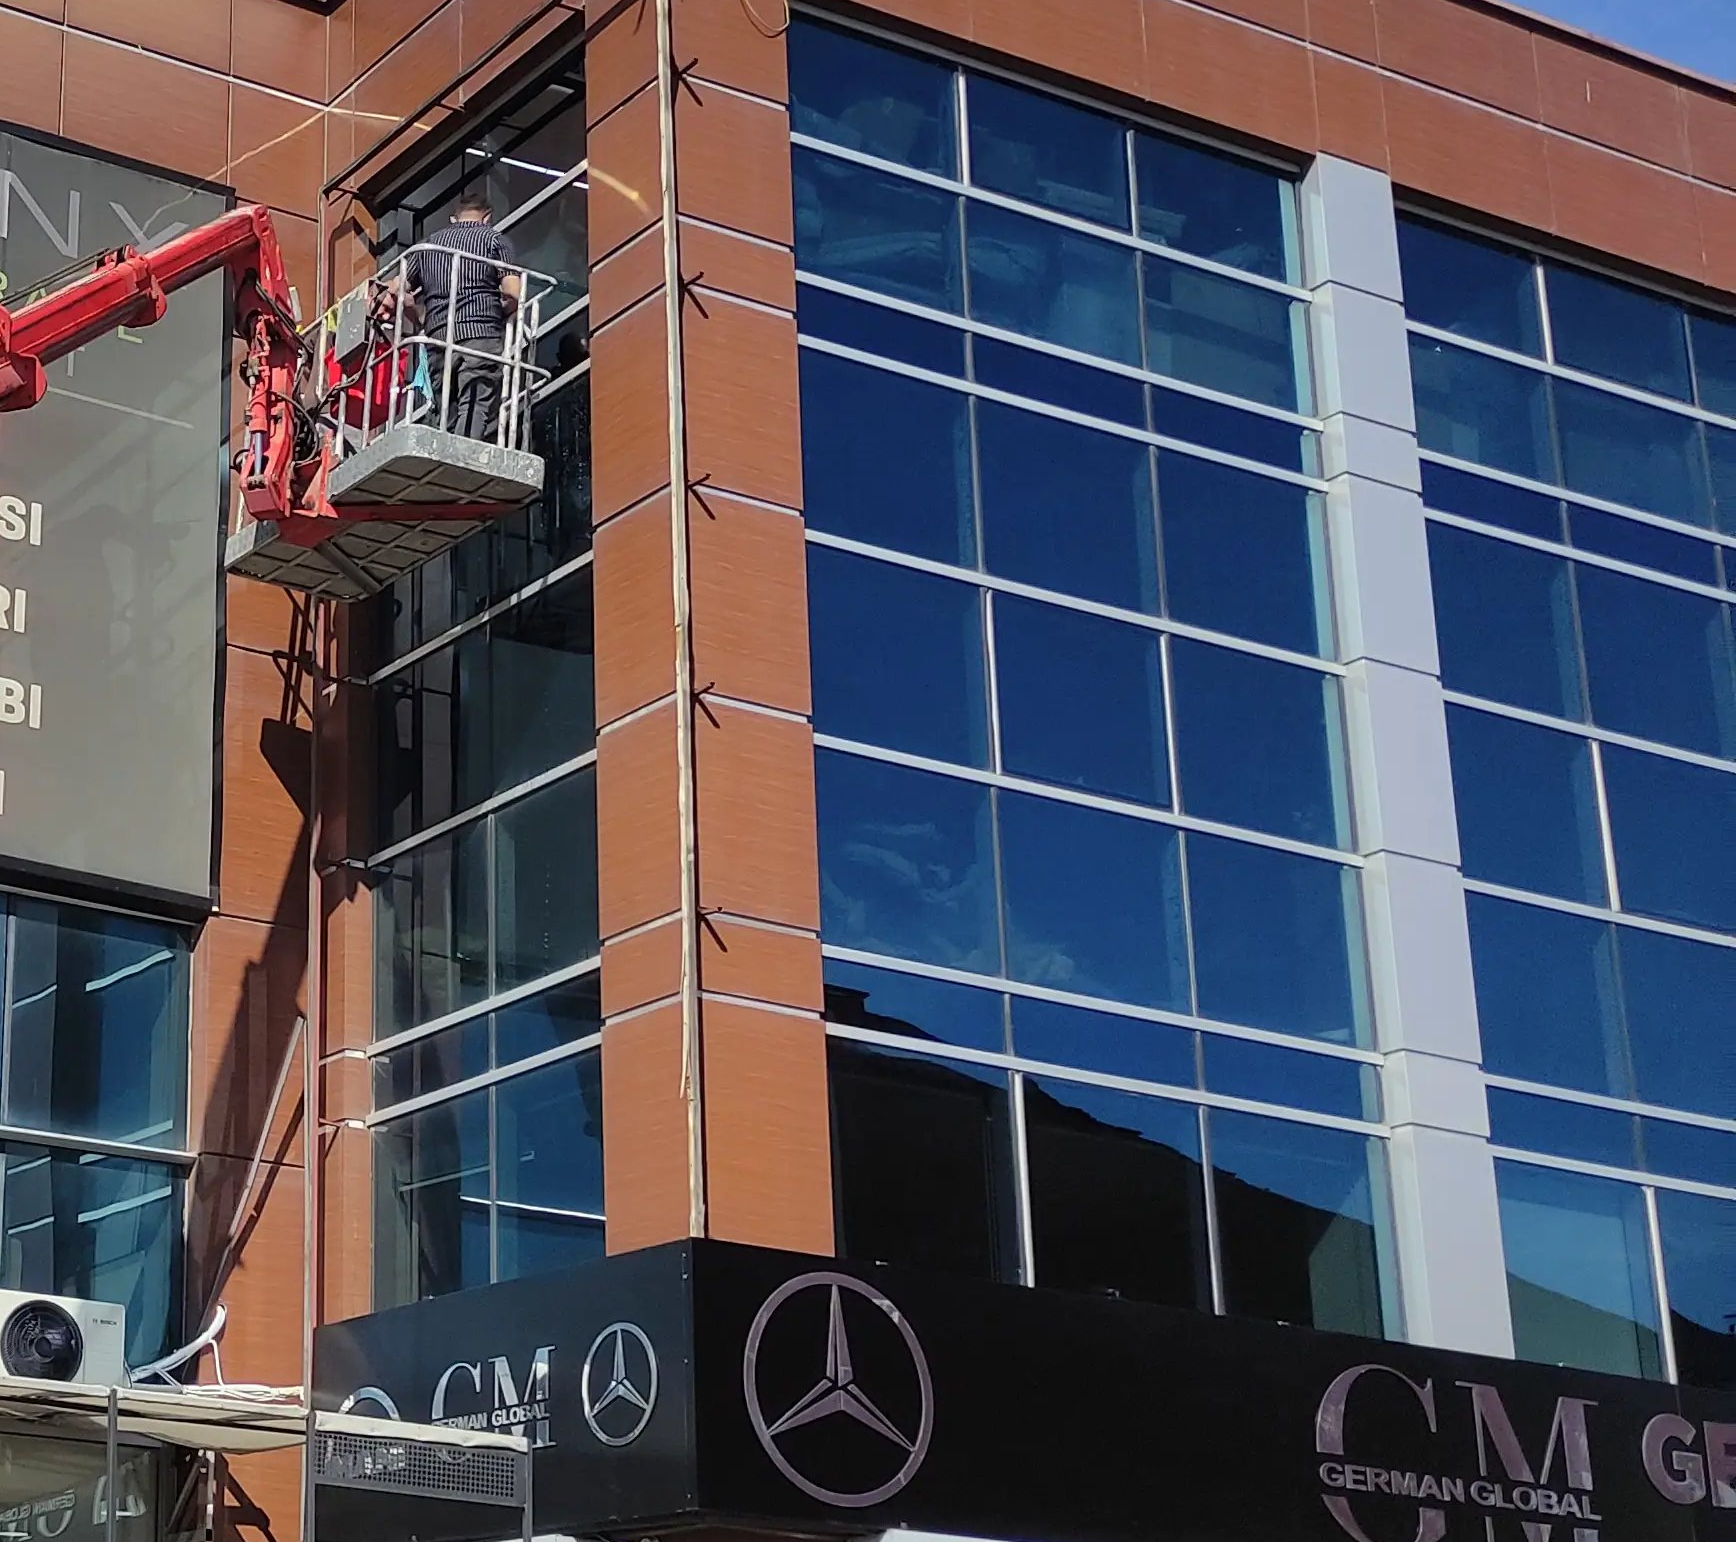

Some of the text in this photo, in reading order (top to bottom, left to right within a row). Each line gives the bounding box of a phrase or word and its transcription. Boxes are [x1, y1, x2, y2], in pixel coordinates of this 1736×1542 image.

[492, 1402, 551, 1427] GLOBAL
[1320, 1462, 1603, 1521] GERMAN GLOBAL
